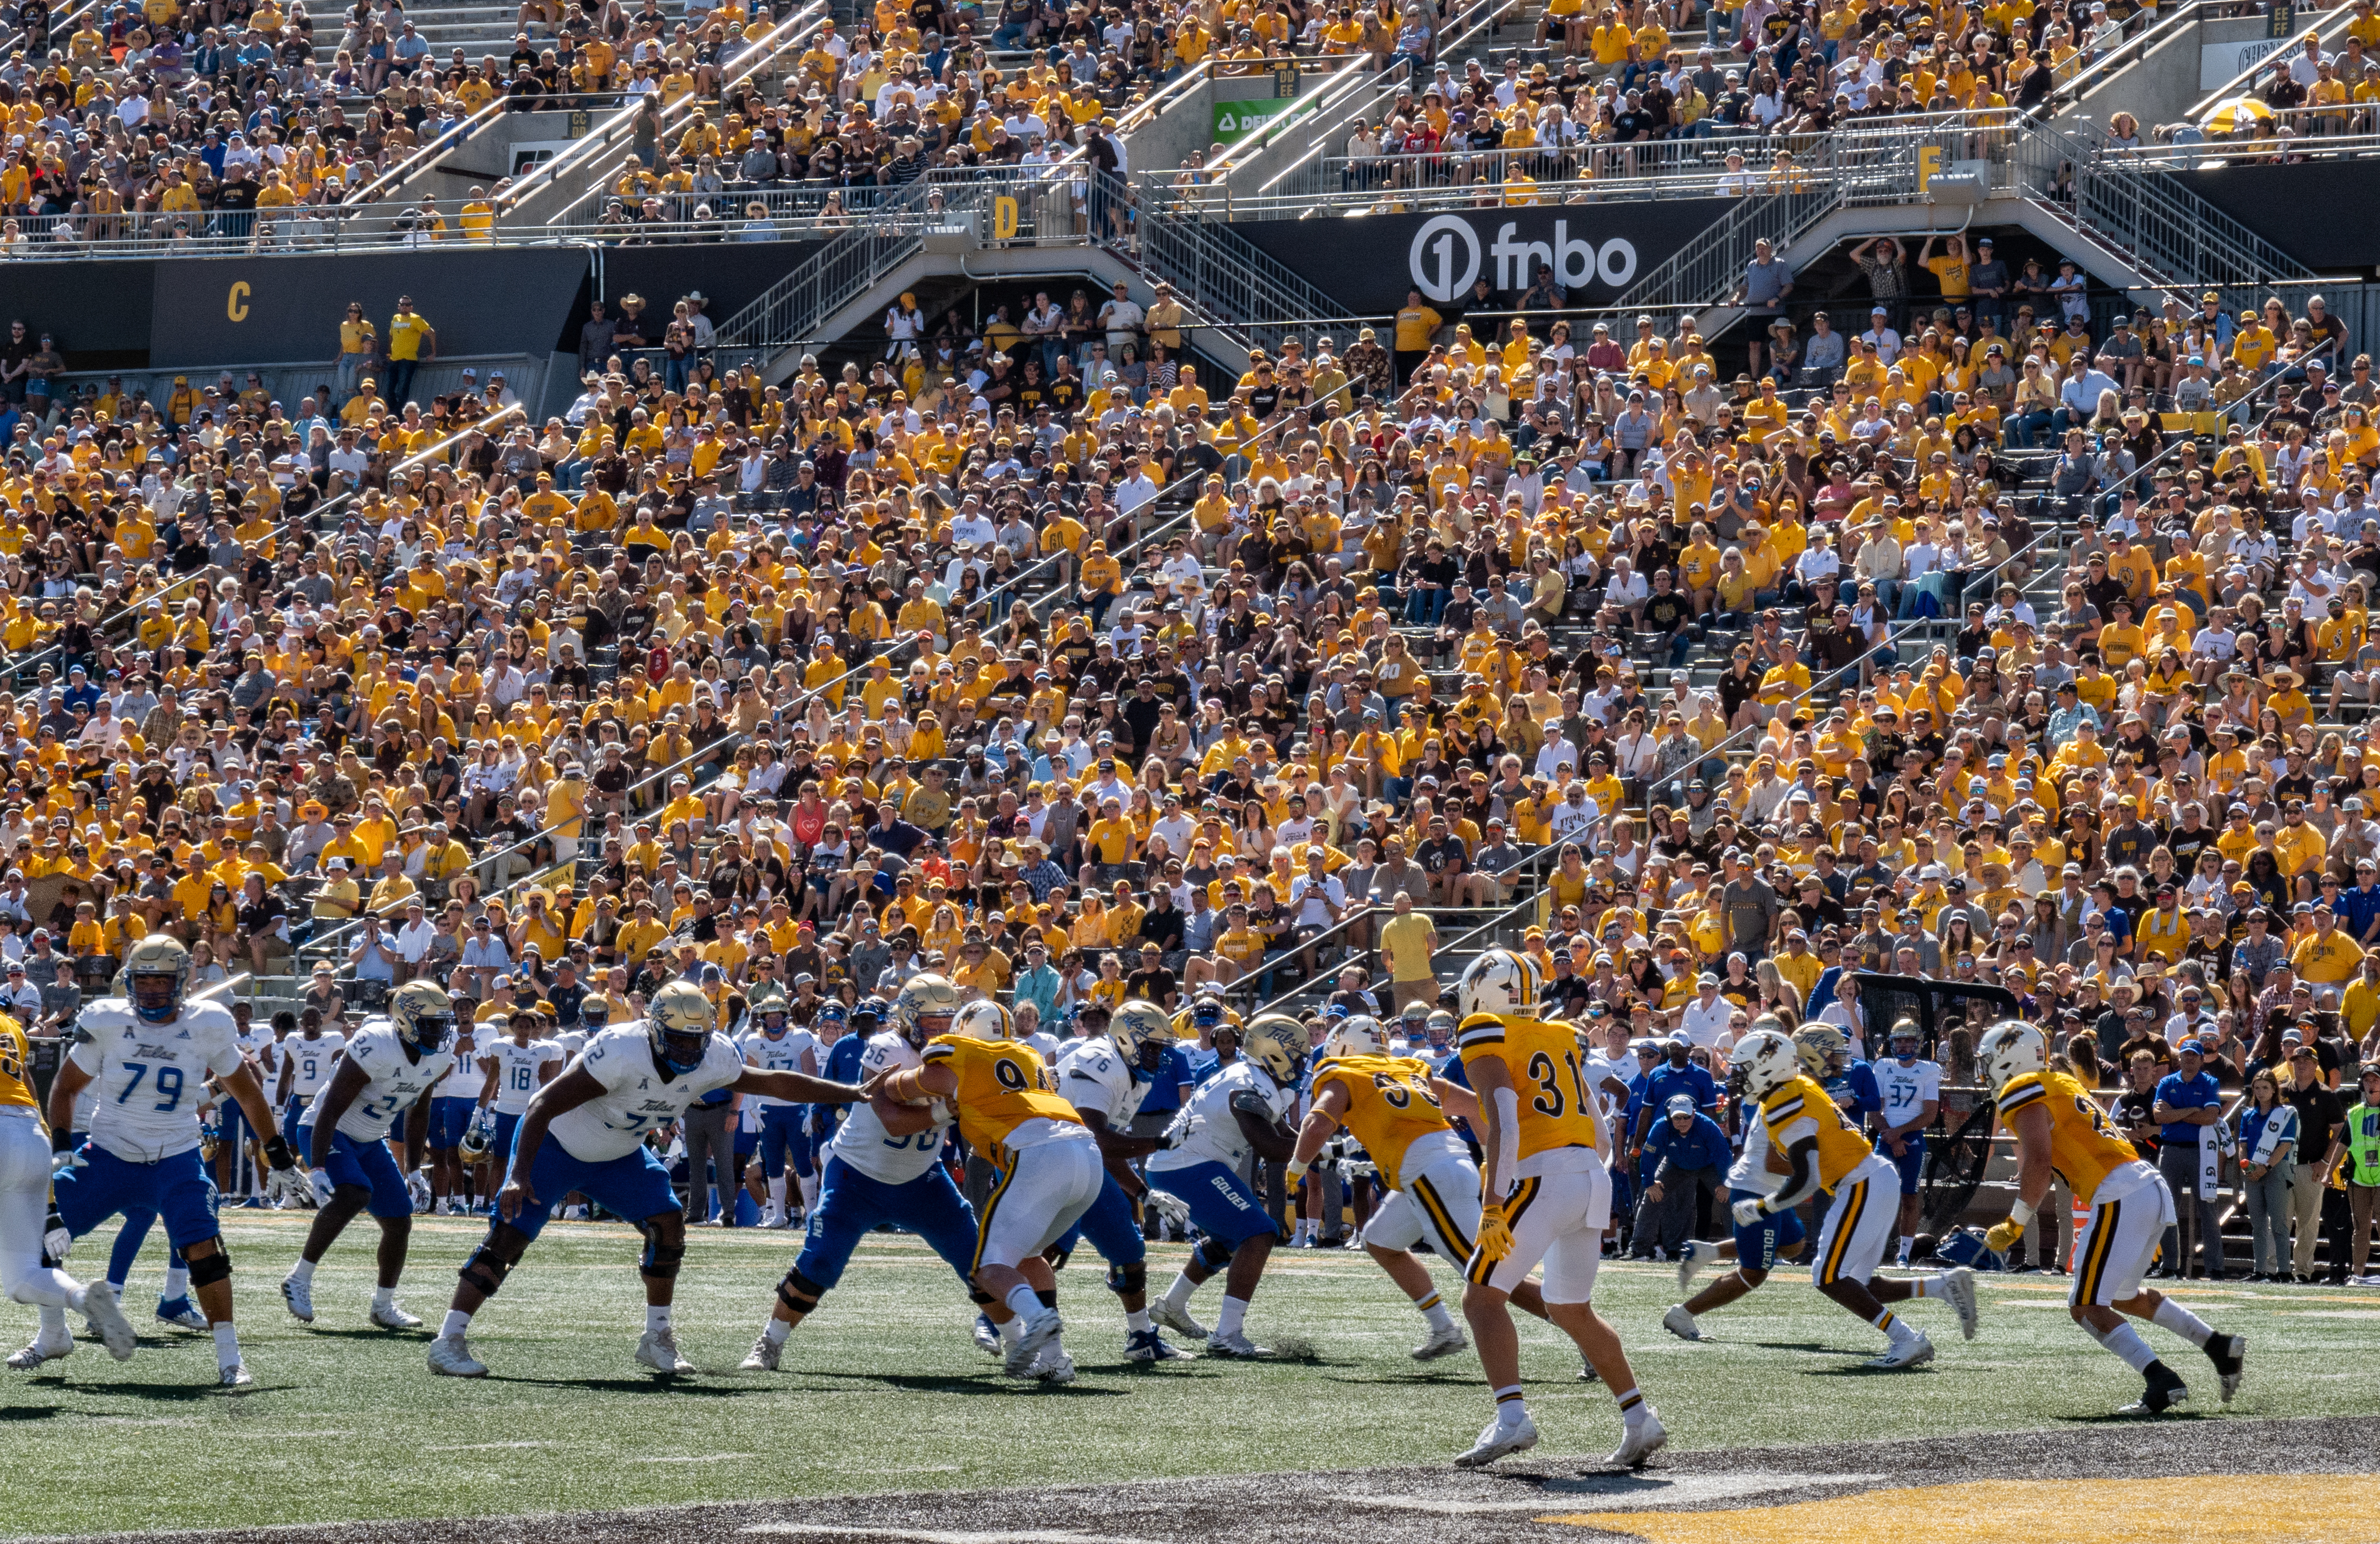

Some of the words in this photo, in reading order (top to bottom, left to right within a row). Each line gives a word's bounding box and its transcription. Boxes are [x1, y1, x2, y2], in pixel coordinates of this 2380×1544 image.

[2274, 6, 2288, 19] EE
[2273, 22, 2287, 36] FF
[1279, 71, 1294, 83] DD
[1280, 84, 1293, 97] EE
[571, 113, 587, 125] CC
[572, 127, 587, 138] DD
[996, 197, 1017, 238] D
[1491, 220, 1637, 290] fnbo
[228, 281, 251, 322] C
[1378, 663, 1400, 678] GO
[353, 1036, 373, 1059] 24
[1265, 1025, 1304, 1050] Tulsa
[132, 1044, 178, 1061] Tulsa
[512, 1057, 532, 1065] Tulsa
[766, 1051, 787, 1059] Tulsa
[1086, 1049, 1109, 1073] 76
[304, 1060, 316, 1080] 9
[511, 1067, 531, 1090] 18
[118, 1062, 184, 1112] 79
[391, 1082, 421, 1093] Tulsa
[1527, 1049, 1589, 1119] 31
[638, 1099, 676, 1112] Tulsa
[1889, 1085, 1917, 1107] 37
[1211, 1176, 1251, 1211] GOLDEN
[1761, 1229, 1775, 1271] GOLDEN
